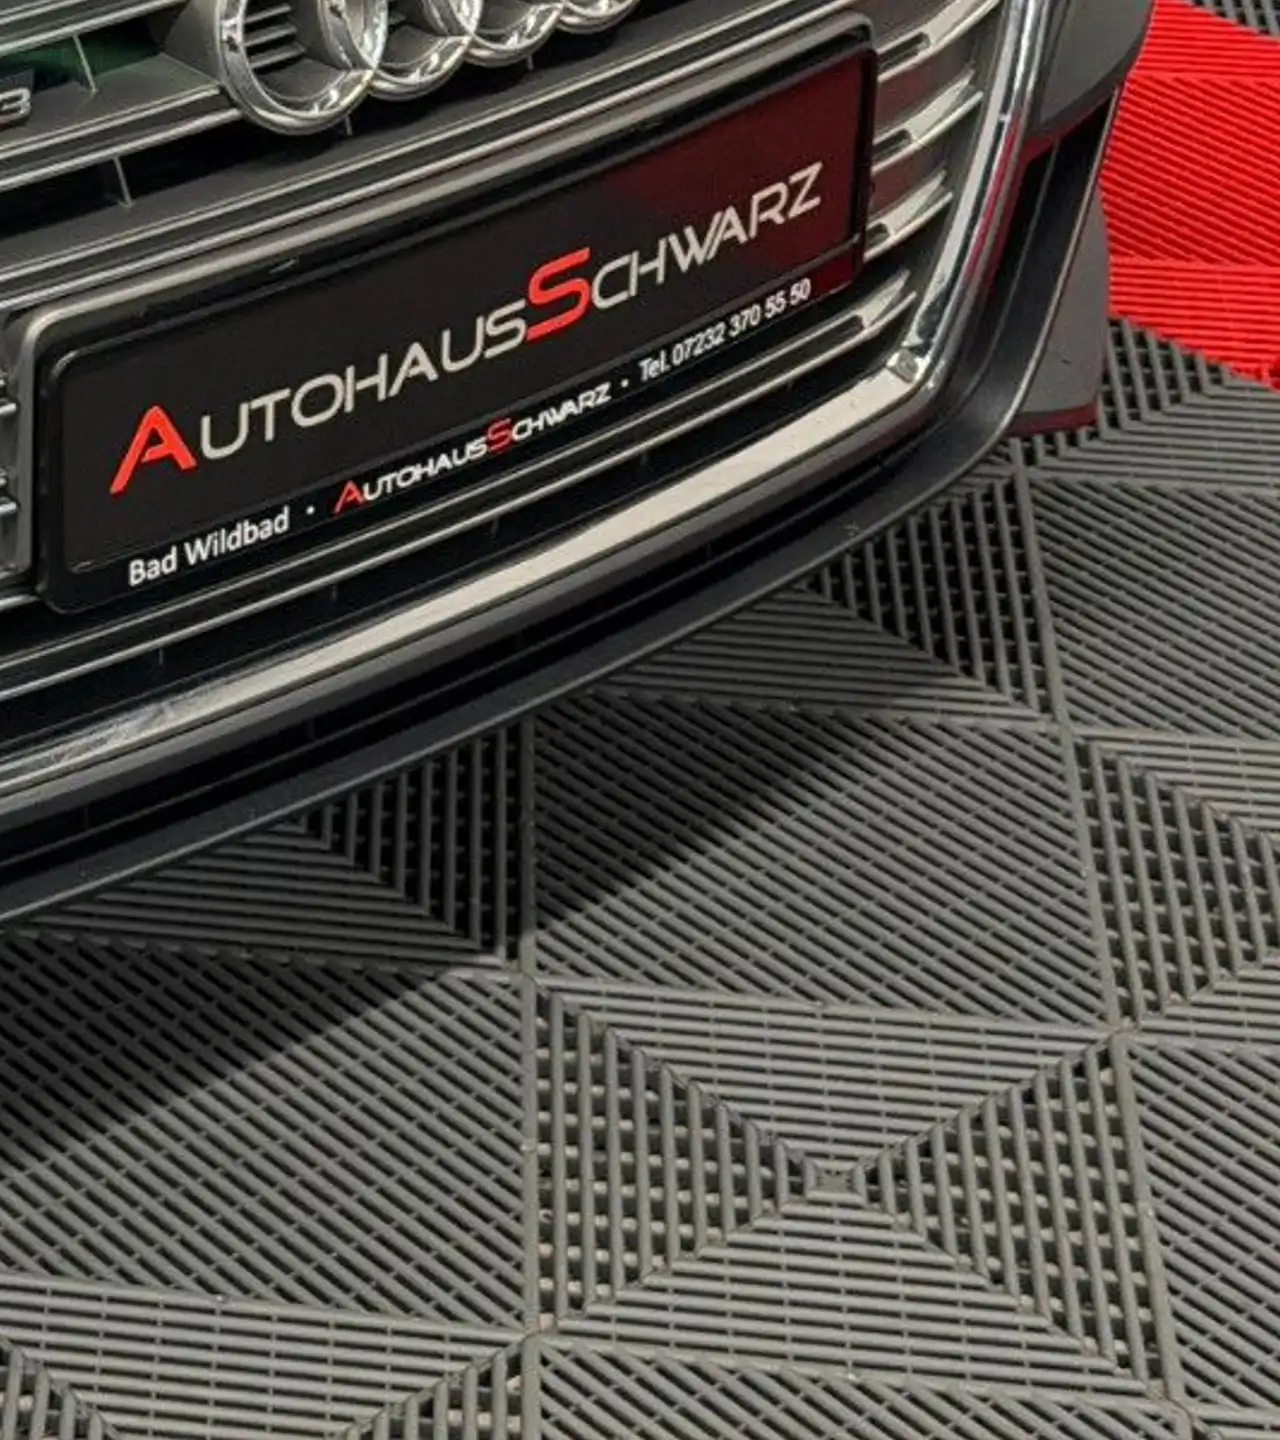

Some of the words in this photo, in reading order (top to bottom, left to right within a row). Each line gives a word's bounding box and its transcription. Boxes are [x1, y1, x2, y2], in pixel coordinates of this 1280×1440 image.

[128, 545, 178, 587] Bad
[184, 505, 291, 565] Wildbad
[638, 350, 670, 381] Tel.
[671, 322, 725, 366] 07232
[729, 303, 762, 337] 370
[765, 290, 788, 318] 55
[790, 278, 812, 303] 50
